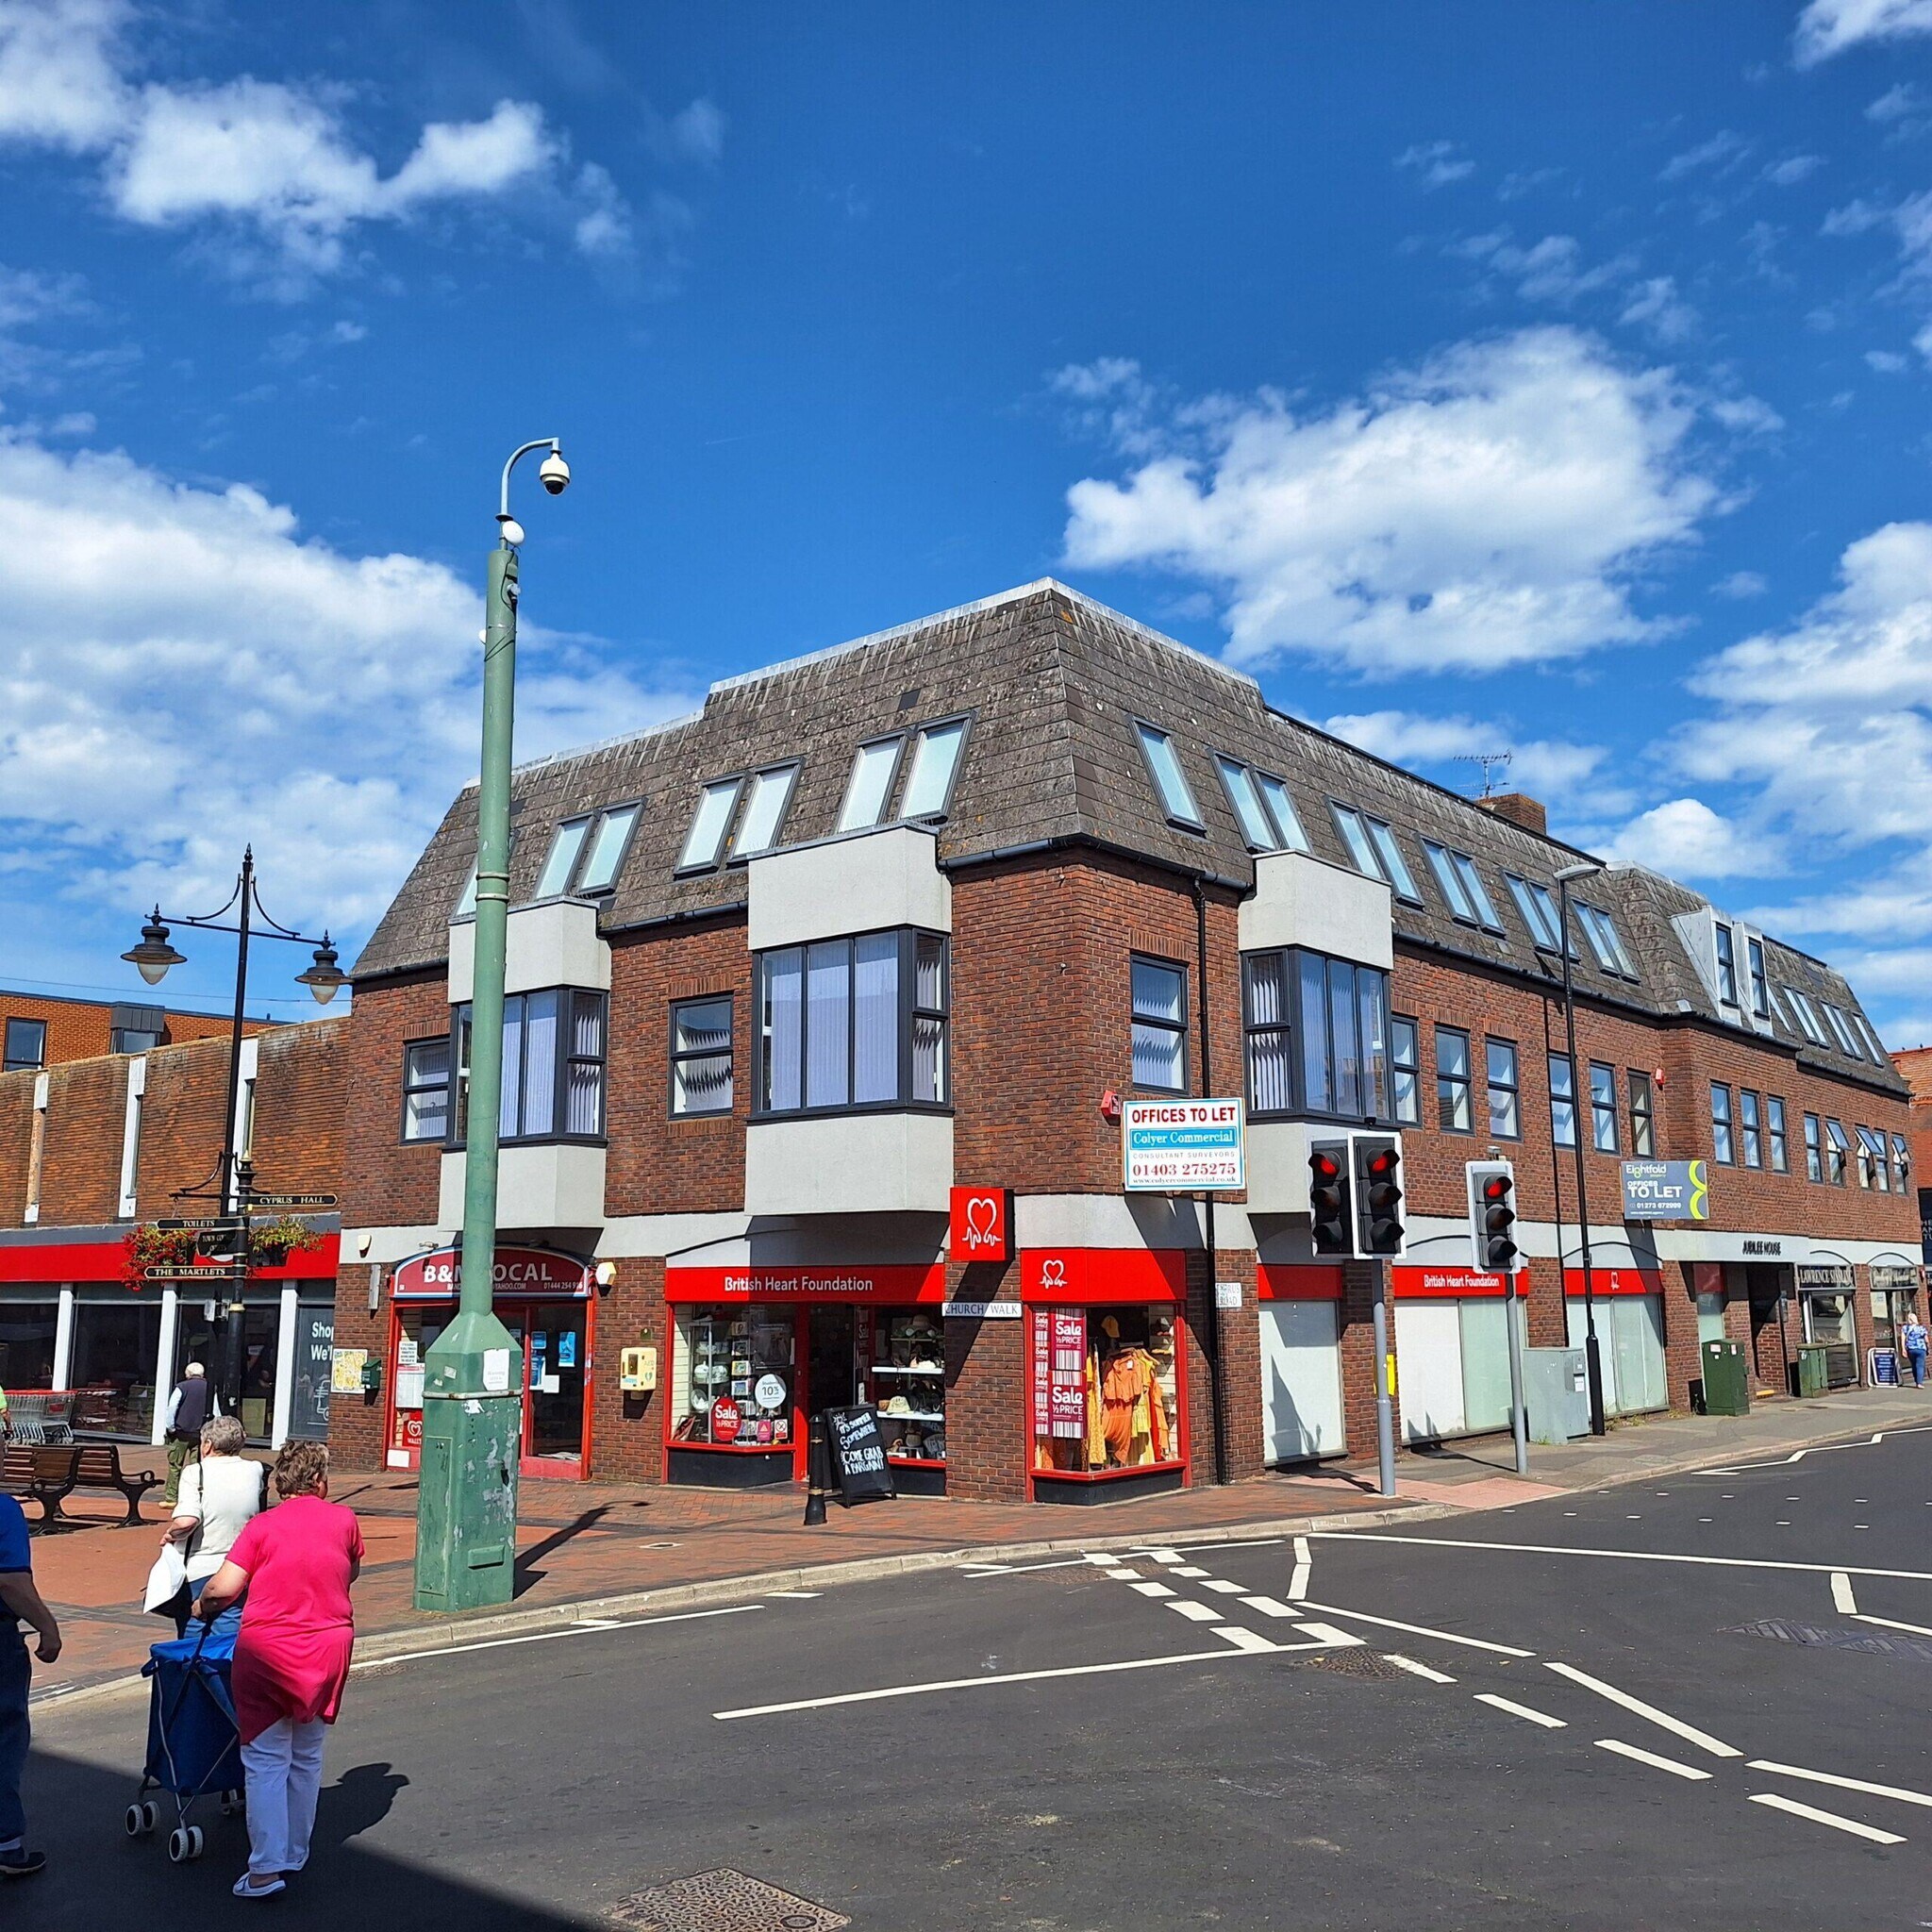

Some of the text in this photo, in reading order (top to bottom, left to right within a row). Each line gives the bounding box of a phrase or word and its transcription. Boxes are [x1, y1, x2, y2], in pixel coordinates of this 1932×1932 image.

[1132, 1108, 1186, 1124] OFFICES
[1190, 1108, 1208, 1122] TO
[1211, 1107, 1236, 1122] LET
[1133, 1130, 1233, 1146] Colyer Commercial
[1133, 1163, 1236, 1176] 01403 275275
[1627, 1186, 1683, 1198] TO LET
[259, 1196, 293, 1205] CYPRUS
[492, 1263, 553, 1282] OCAL
[724, 1275, 873, 1291] British Heart Foundation
[1424, 1274, 1500, 1288] British Heart Foundation
[945, 1304, 1018, 1314] CHURCH WALK
[1056, 1321, 1082, 1336] Sale
[1052, 1386, 1083, 1405] Sale
[715, 1405, 738, 1420] Sale
[842, 1445, 884, 1465] COME GRAB
[844, 1464, 852, 1475] A
